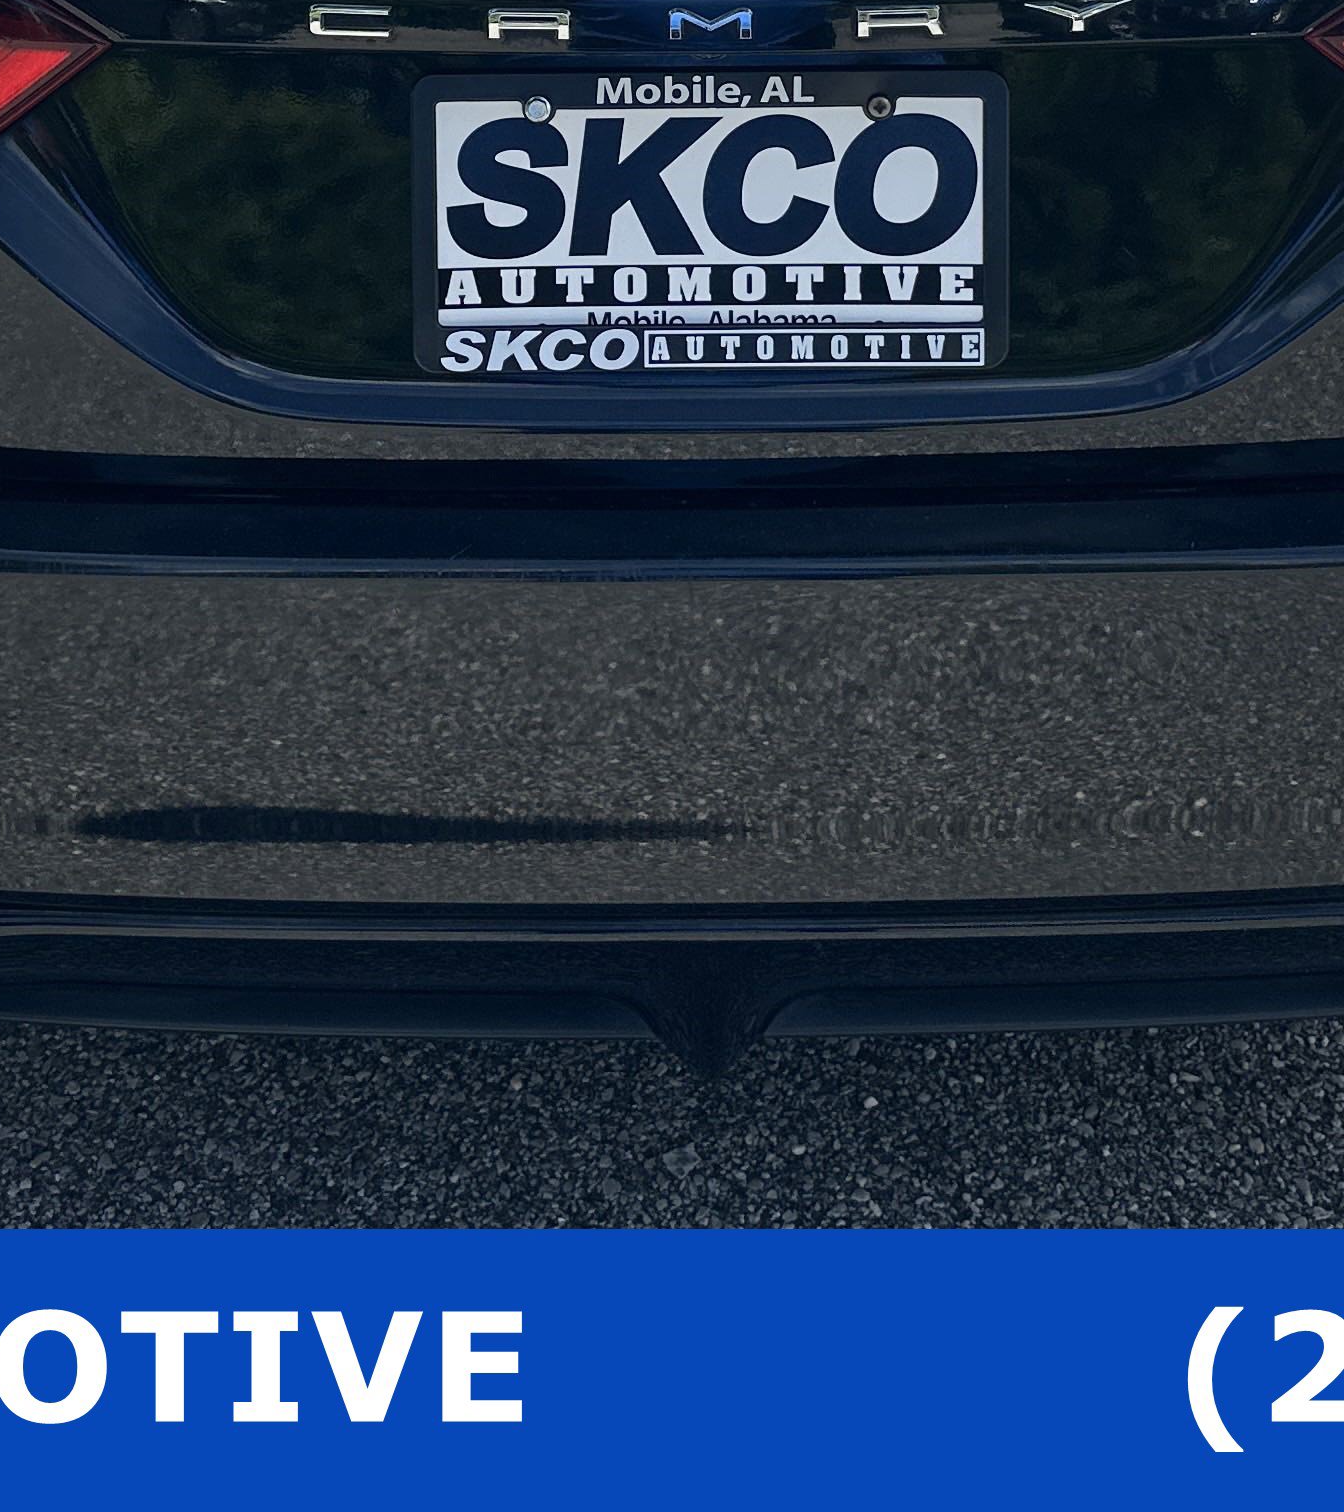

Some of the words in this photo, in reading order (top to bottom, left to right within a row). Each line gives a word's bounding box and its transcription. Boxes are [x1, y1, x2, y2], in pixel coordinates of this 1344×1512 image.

[596, 75, 751, 107] Mobile,
[760, 76, 815, 103] AL
[446, 113, 978, 259] SKCO
[445, 265, 974, 304] AUTOMOTIVE
[440, 329, 640, 371] SKCO
[652, 334, 979, 361] AUTOMOTIVE
